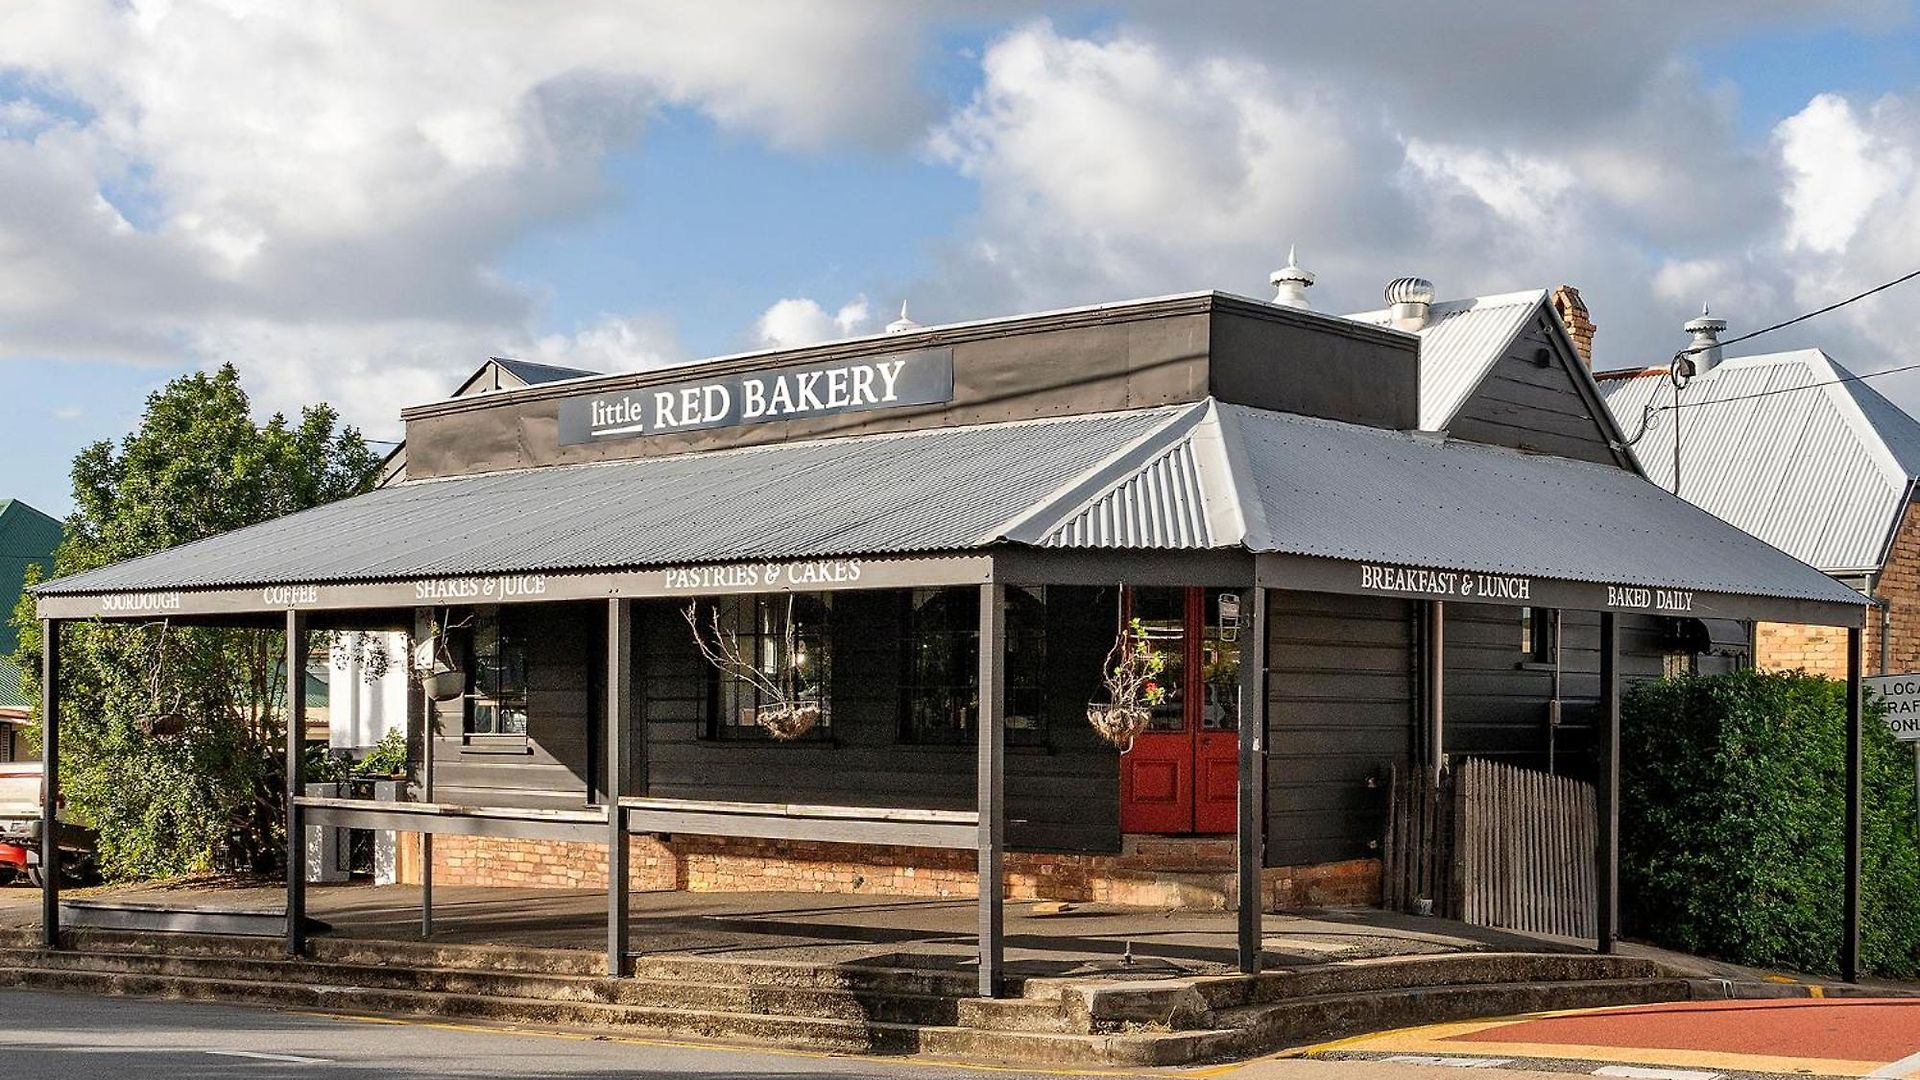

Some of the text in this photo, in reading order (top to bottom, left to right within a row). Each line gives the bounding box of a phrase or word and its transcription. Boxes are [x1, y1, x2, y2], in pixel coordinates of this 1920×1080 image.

[591, 360, 907, 430] little RED BAKERY
[664, 558, 861, 588] PASTRIES & CAKES
[1361, 564, 1530, 599] BREAKFAST & LUNCH
[264, 585, 318, 605] COFFEE
[415, 575, 546, 601] SHAKES & JUICE
[1607, 586, 1693, 611] BAKED DAILY
[102, 592, 181, 611] SOURDOUGH
[1883, 681, 1920, 696] LOC
[1880, 700, 1920, 714] RAF
